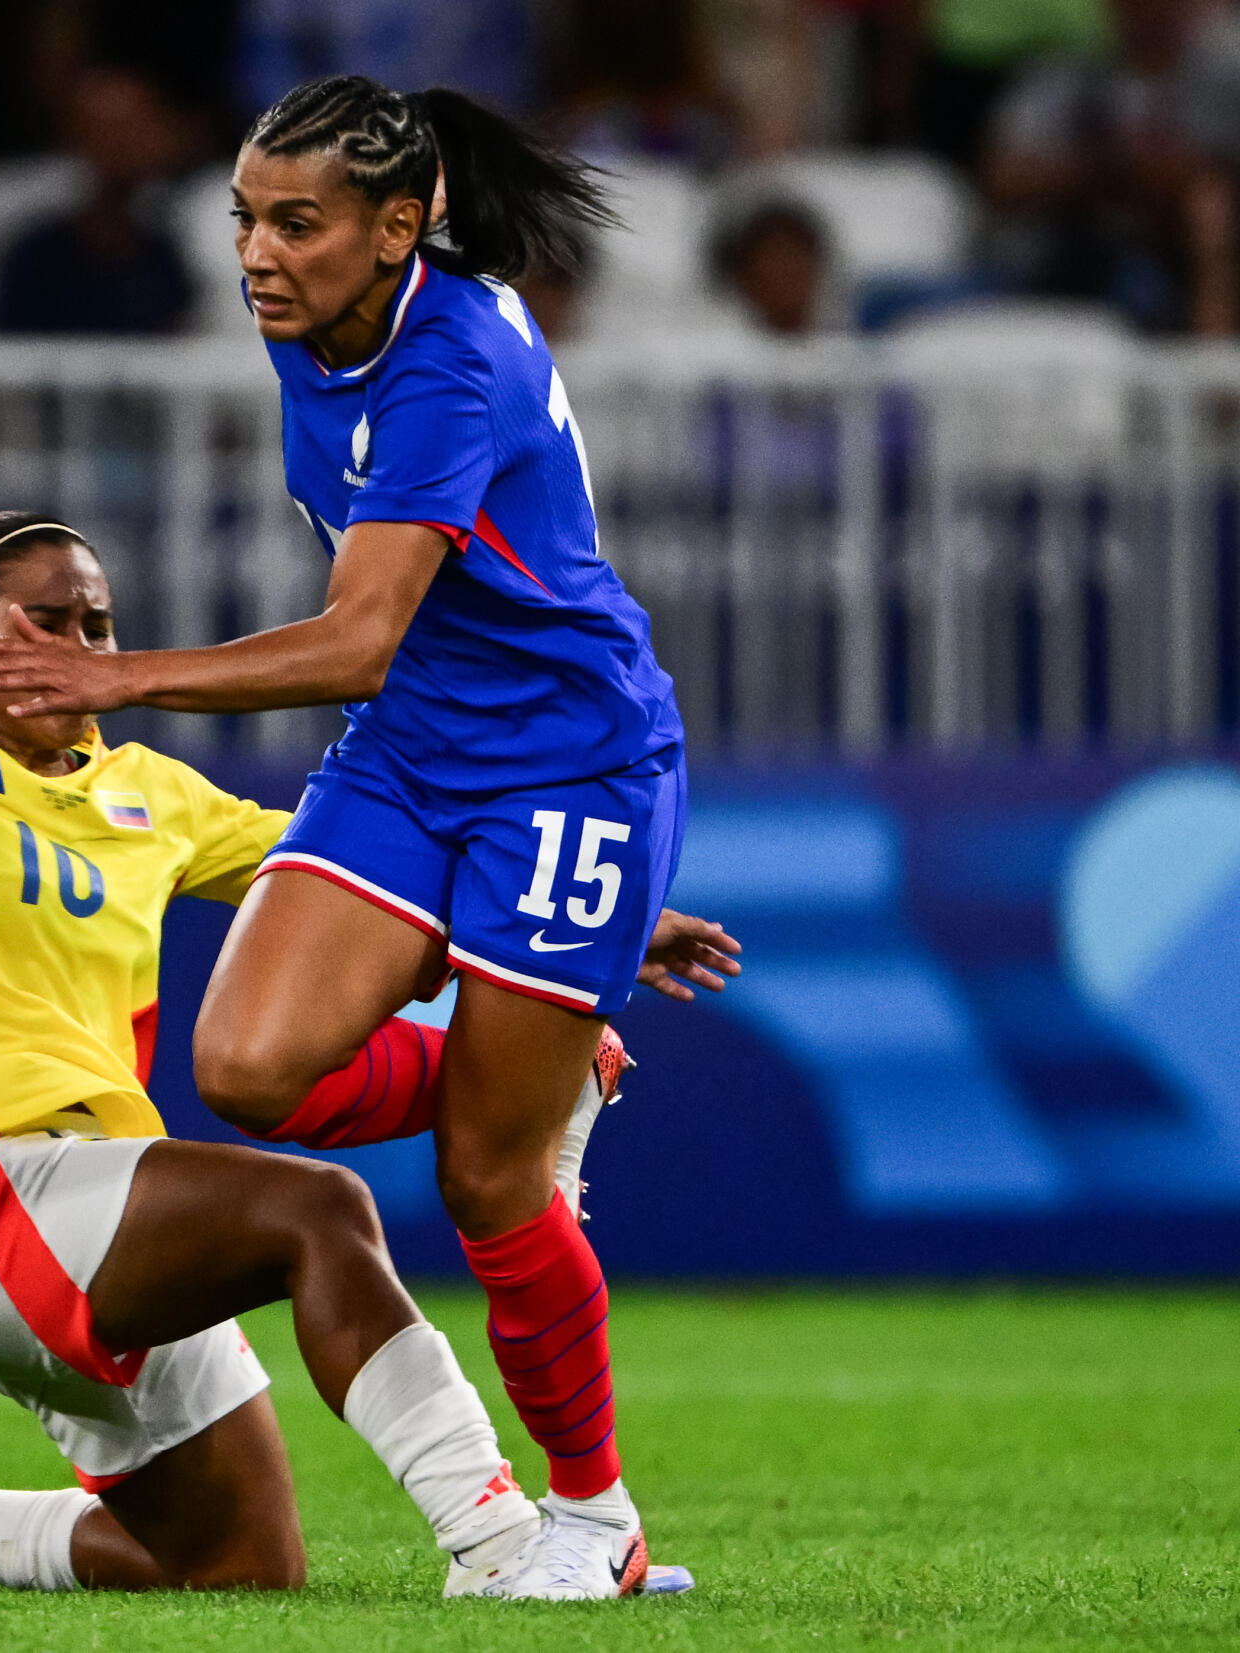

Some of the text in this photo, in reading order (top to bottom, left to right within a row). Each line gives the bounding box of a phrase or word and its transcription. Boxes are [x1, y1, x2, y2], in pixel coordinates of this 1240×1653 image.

[342, 467, 368, 489] FRANC
[16, 820, 106, 918] 10
[516, 809, 632, 929] 15
